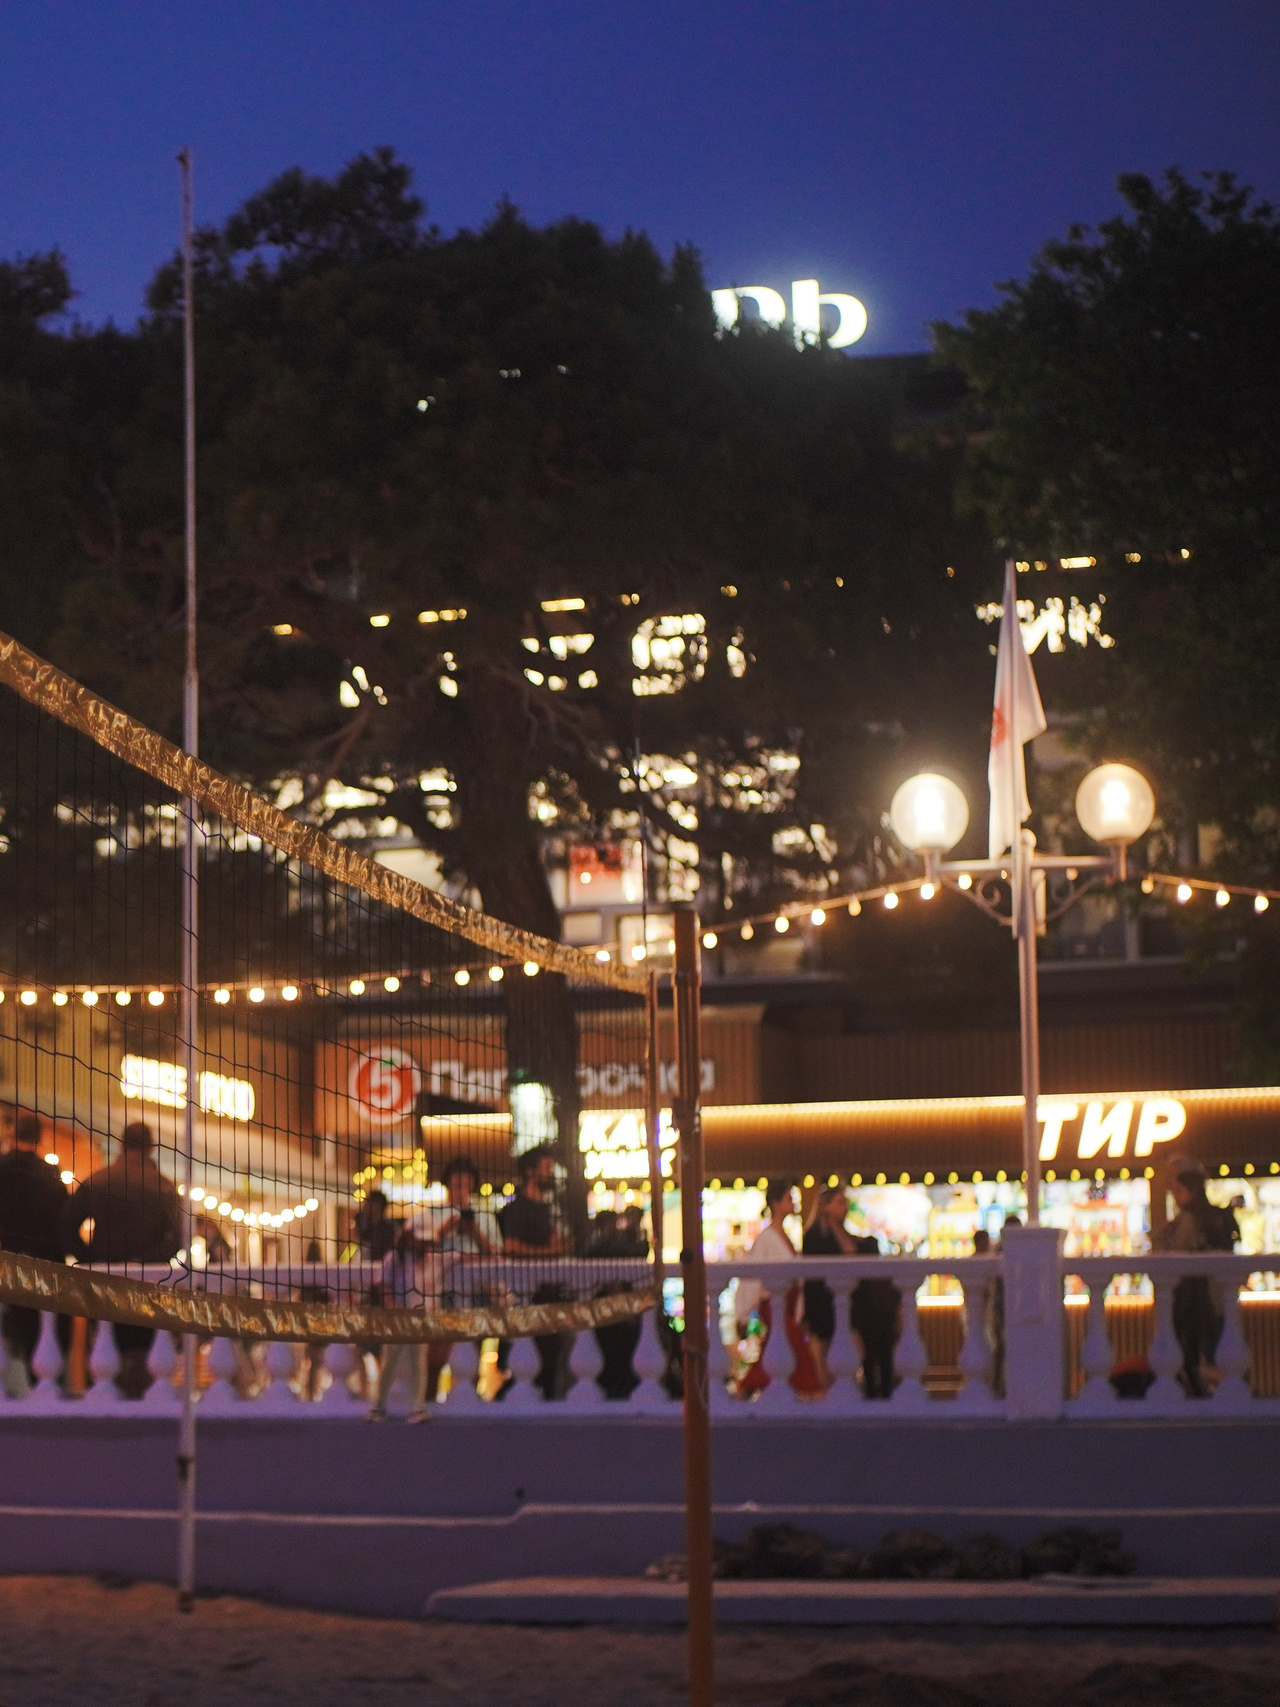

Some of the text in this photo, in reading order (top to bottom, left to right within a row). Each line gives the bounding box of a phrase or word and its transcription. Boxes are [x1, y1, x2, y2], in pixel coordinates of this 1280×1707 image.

[120, 1054, 193, 1110] STREE
[430, 1059, 716, 1102] Пятрочка
[1036, 1098, 1187, 1161] ТИР
